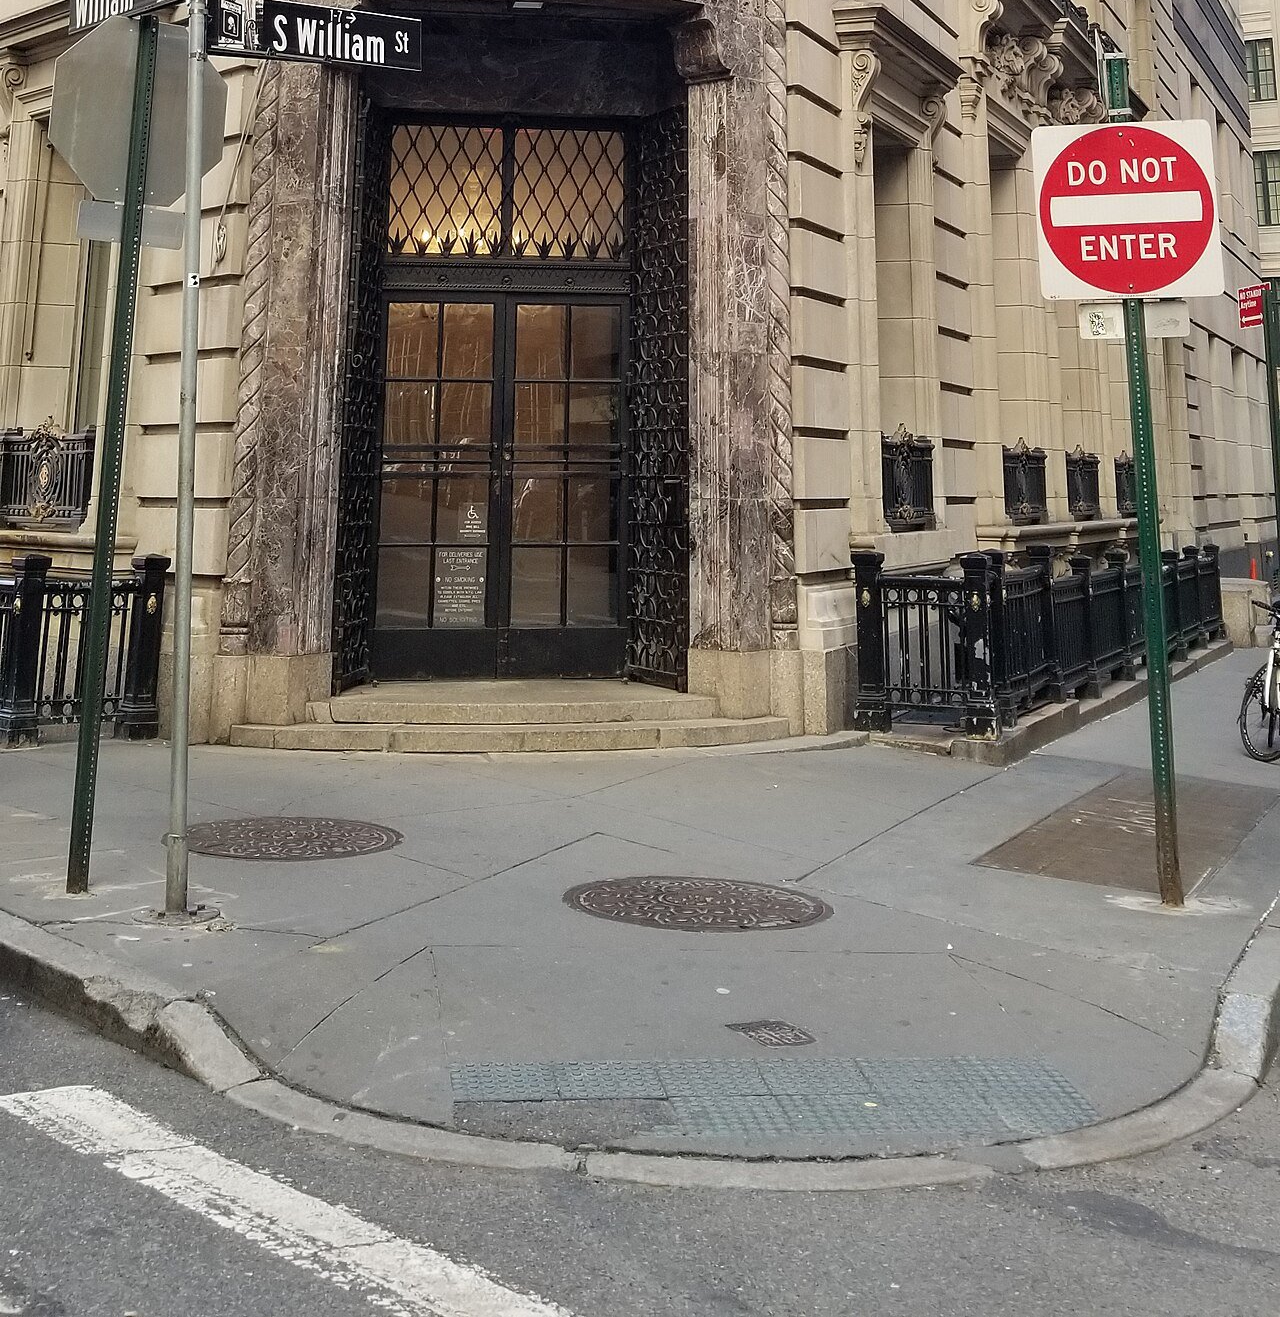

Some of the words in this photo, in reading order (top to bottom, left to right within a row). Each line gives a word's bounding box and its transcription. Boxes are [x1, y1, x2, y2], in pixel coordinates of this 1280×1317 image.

[329, 9, 343, 23] 1-7
[272, 14, 288, 52] S
[296, 17, 385, 64] William
[394, 30, 409, 54] St
[1067, 159, 1107, 186] DO
[1119, 156, 1177, 184] NOT
[1080, 233, 1178, 261] ENTER
